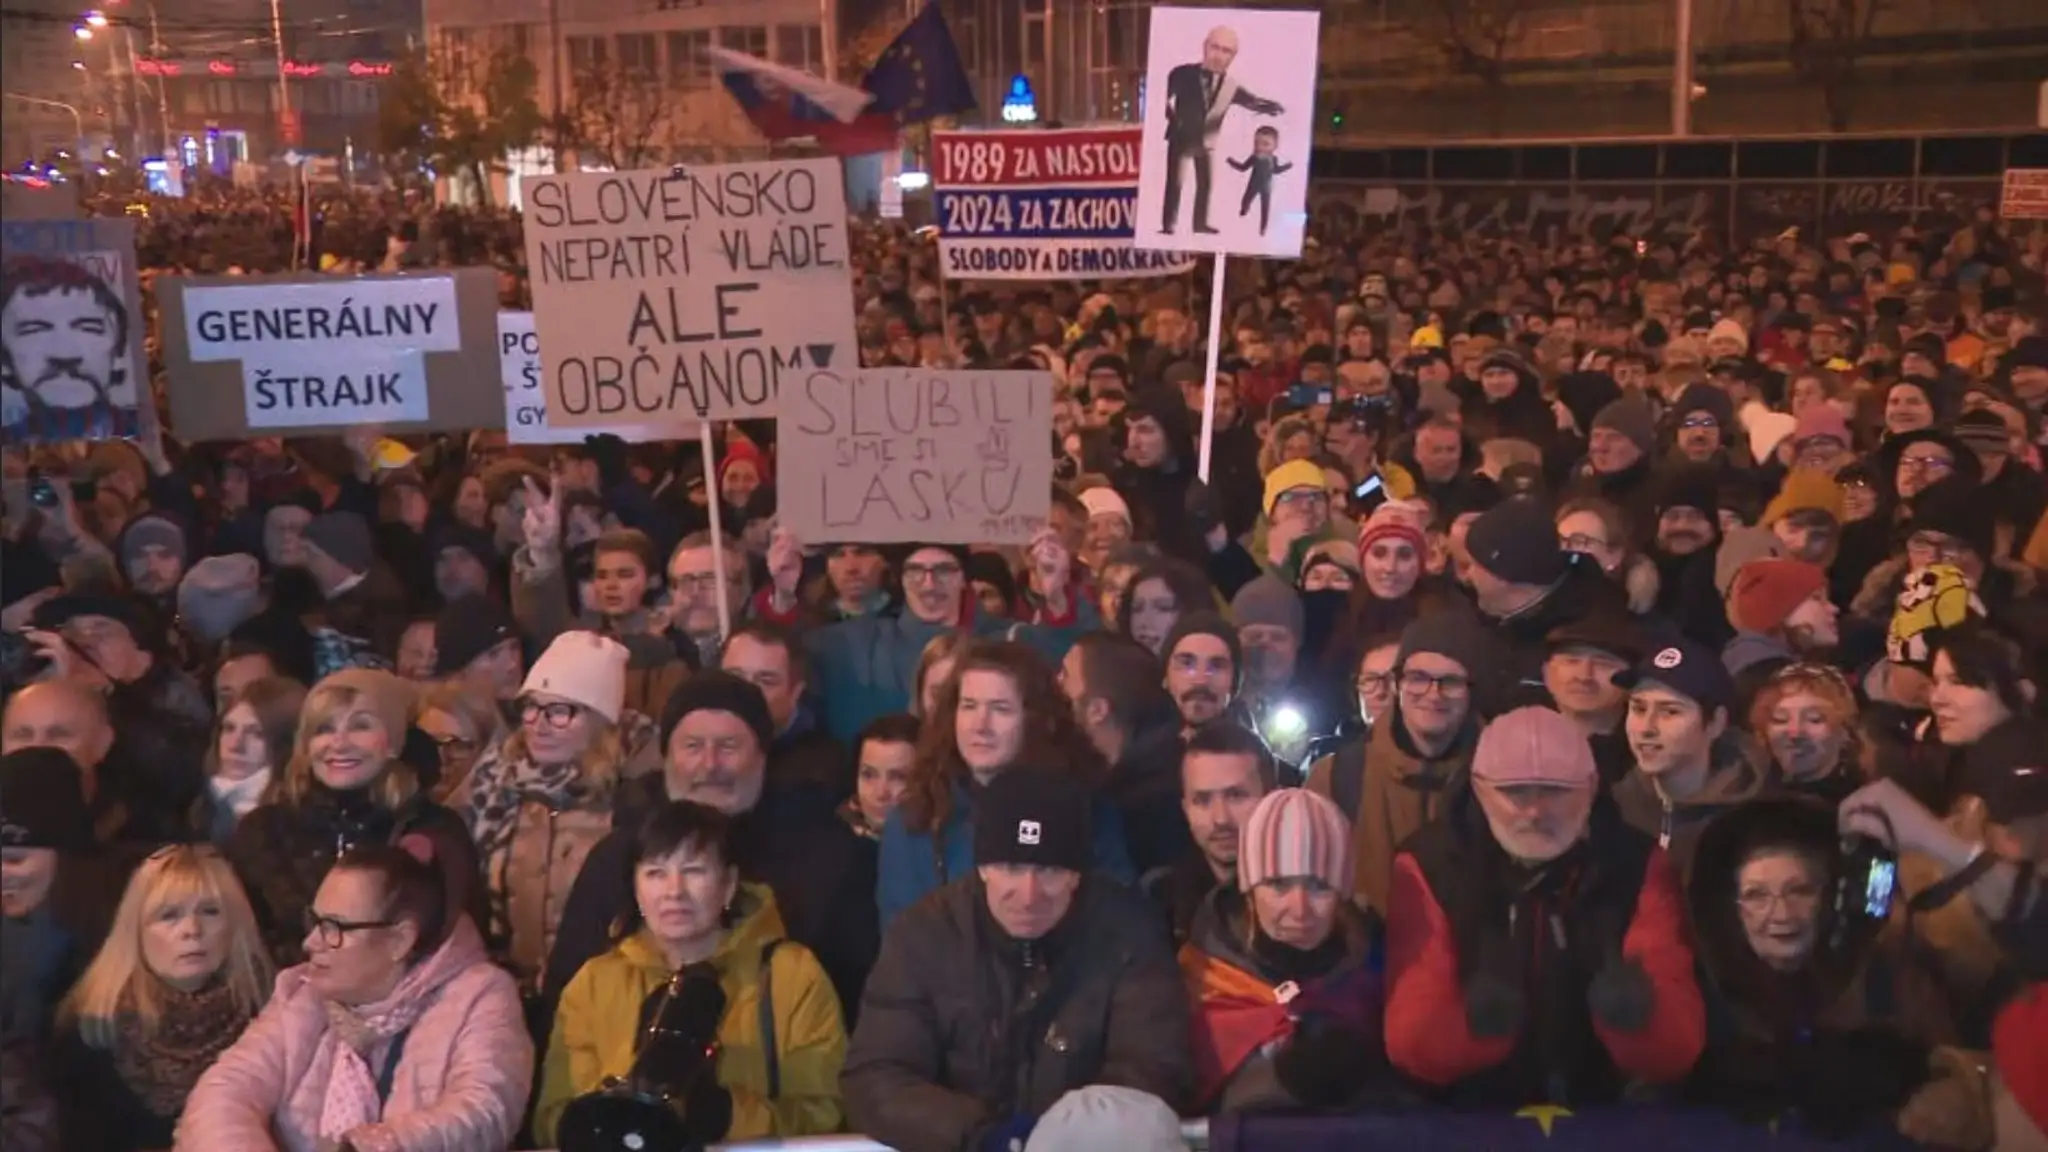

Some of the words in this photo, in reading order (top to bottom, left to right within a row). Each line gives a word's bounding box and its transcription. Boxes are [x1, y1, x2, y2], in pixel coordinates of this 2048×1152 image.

[941, 141, 1005, 182] 1989
[1014, 147, 1040, 178] ZA
[532, 169, 816, 227] SLOVENSKO
[943, 195, 1013, 233] 2024
[1019, 200, 1044, 229] ZA
[540, 224, 691, 284] NEPATRÍ
[950, 246, 1041, 272] SLOBODY
[196, 297, 438, 342] GENERÁLNY
[628, 282, 763, 346] ALE
[254, 368, 403, 410] ŠTRAJK
[836, 437, 896, 468] SME
[822, 464, 1022, 528] LÁSKU
